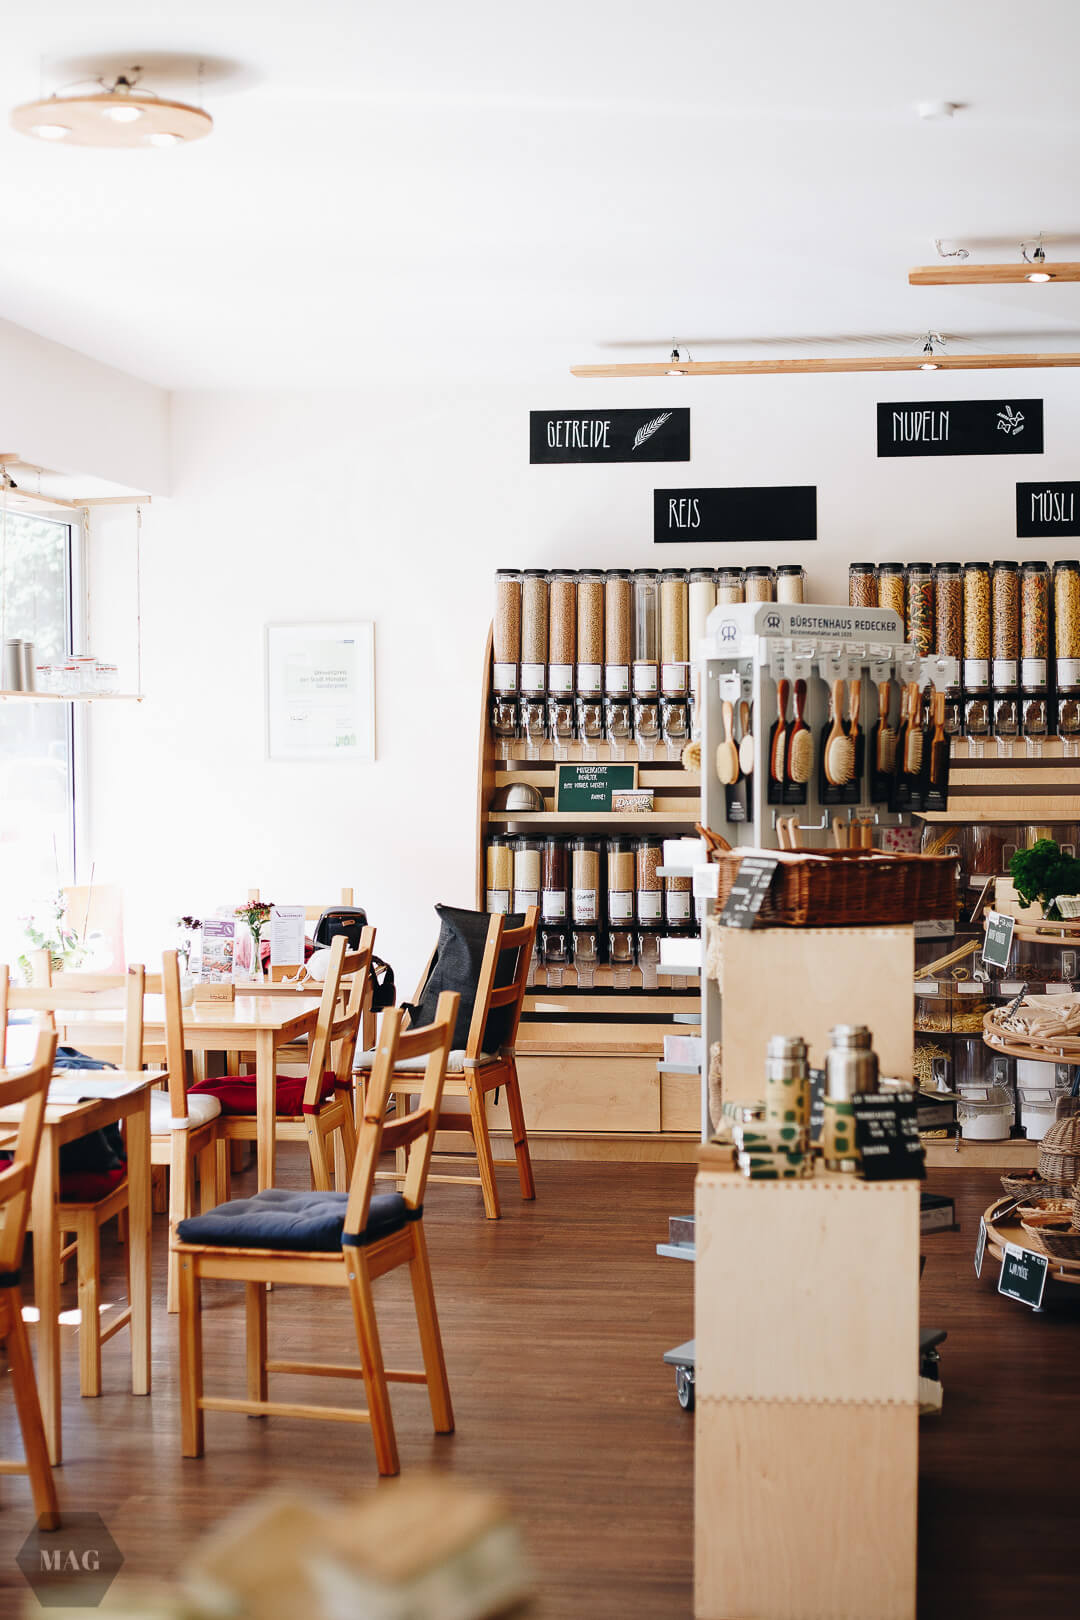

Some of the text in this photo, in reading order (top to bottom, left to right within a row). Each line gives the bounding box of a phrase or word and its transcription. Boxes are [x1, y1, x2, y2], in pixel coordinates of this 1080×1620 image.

[547, 420, 611, 448] GETREIDE
[892, 410, 949, 442] NUDELN
[669, 498, 701, 528] REIS
[1031, 489, 1074, 522] MÜSLI
[790, 614, 897, 632] BÜRSTENHAUS REDECKER
